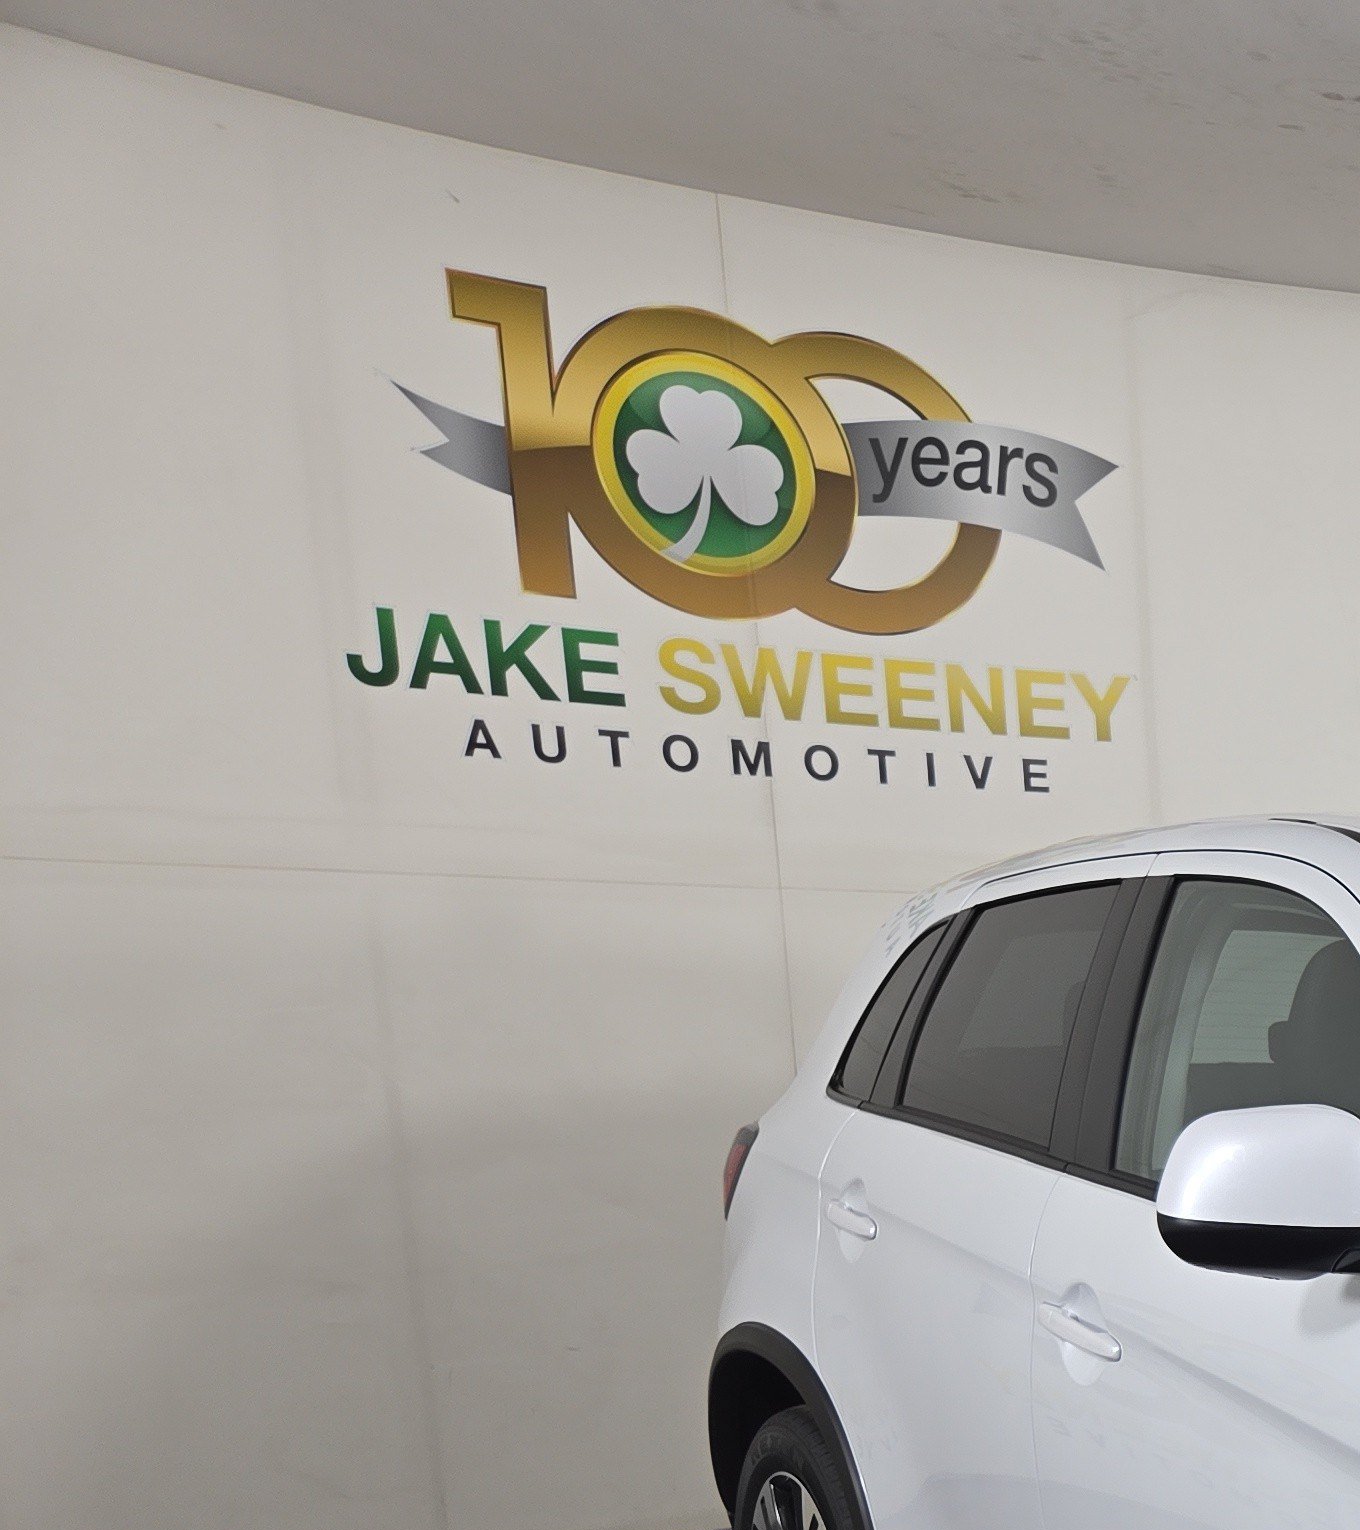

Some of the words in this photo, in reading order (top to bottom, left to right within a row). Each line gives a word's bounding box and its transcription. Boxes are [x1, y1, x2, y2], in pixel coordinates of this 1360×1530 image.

[868, 435, 1060, 508] years
[346, 606, 627, 707] JAKE
[658, 637, 1131, 742] SWEENEY
[464, 719, 1050, 794] AUTOMOTIVE
